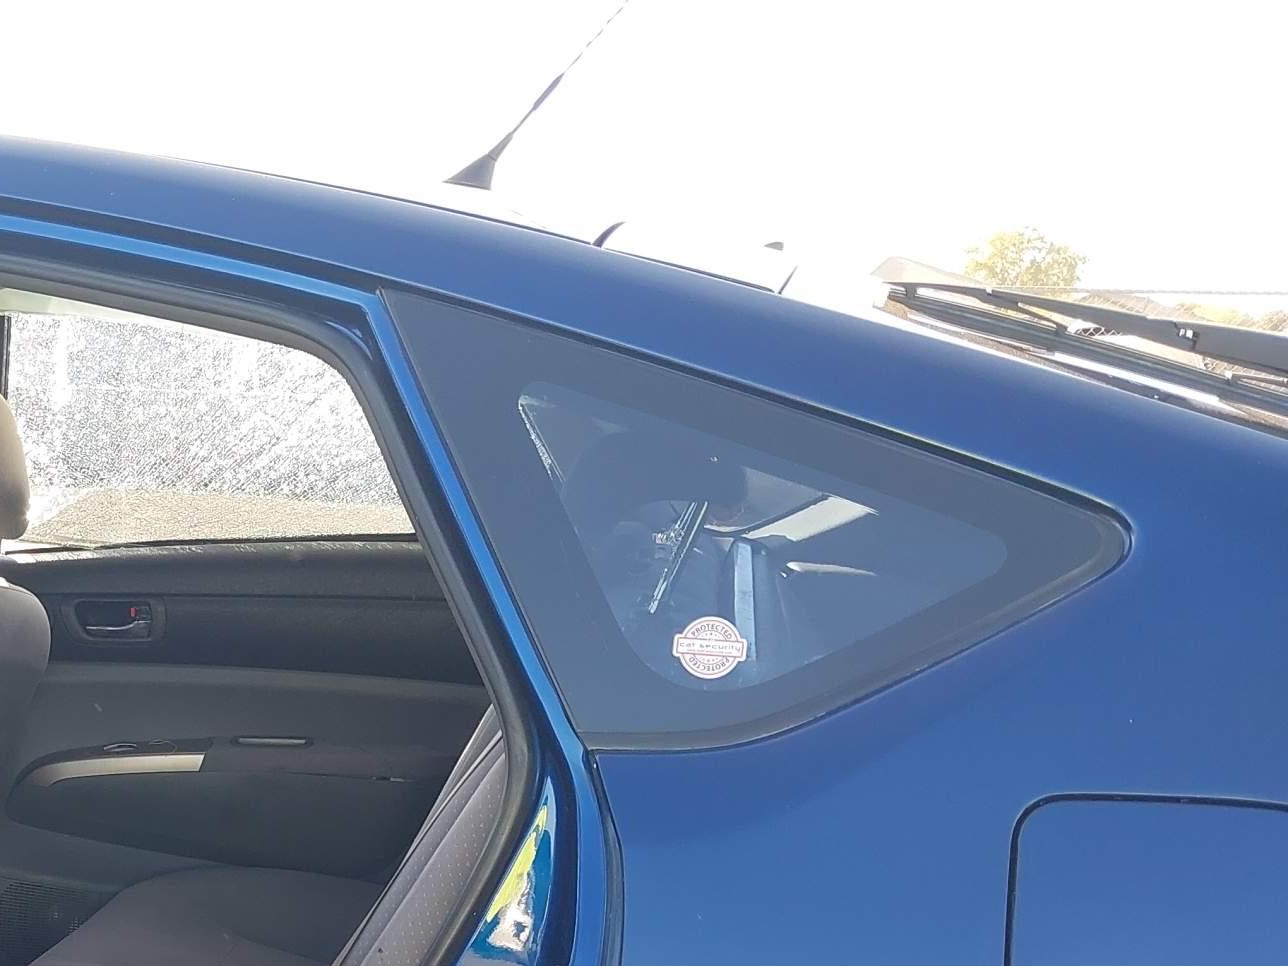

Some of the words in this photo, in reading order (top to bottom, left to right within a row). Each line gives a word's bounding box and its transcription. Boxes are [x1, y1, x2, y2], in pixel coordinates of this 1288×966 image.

[691, 623, 732, 640] PROTECTED
[699, 643, 741, 652] security
[688, 656, 730, 672] PROTECTED
